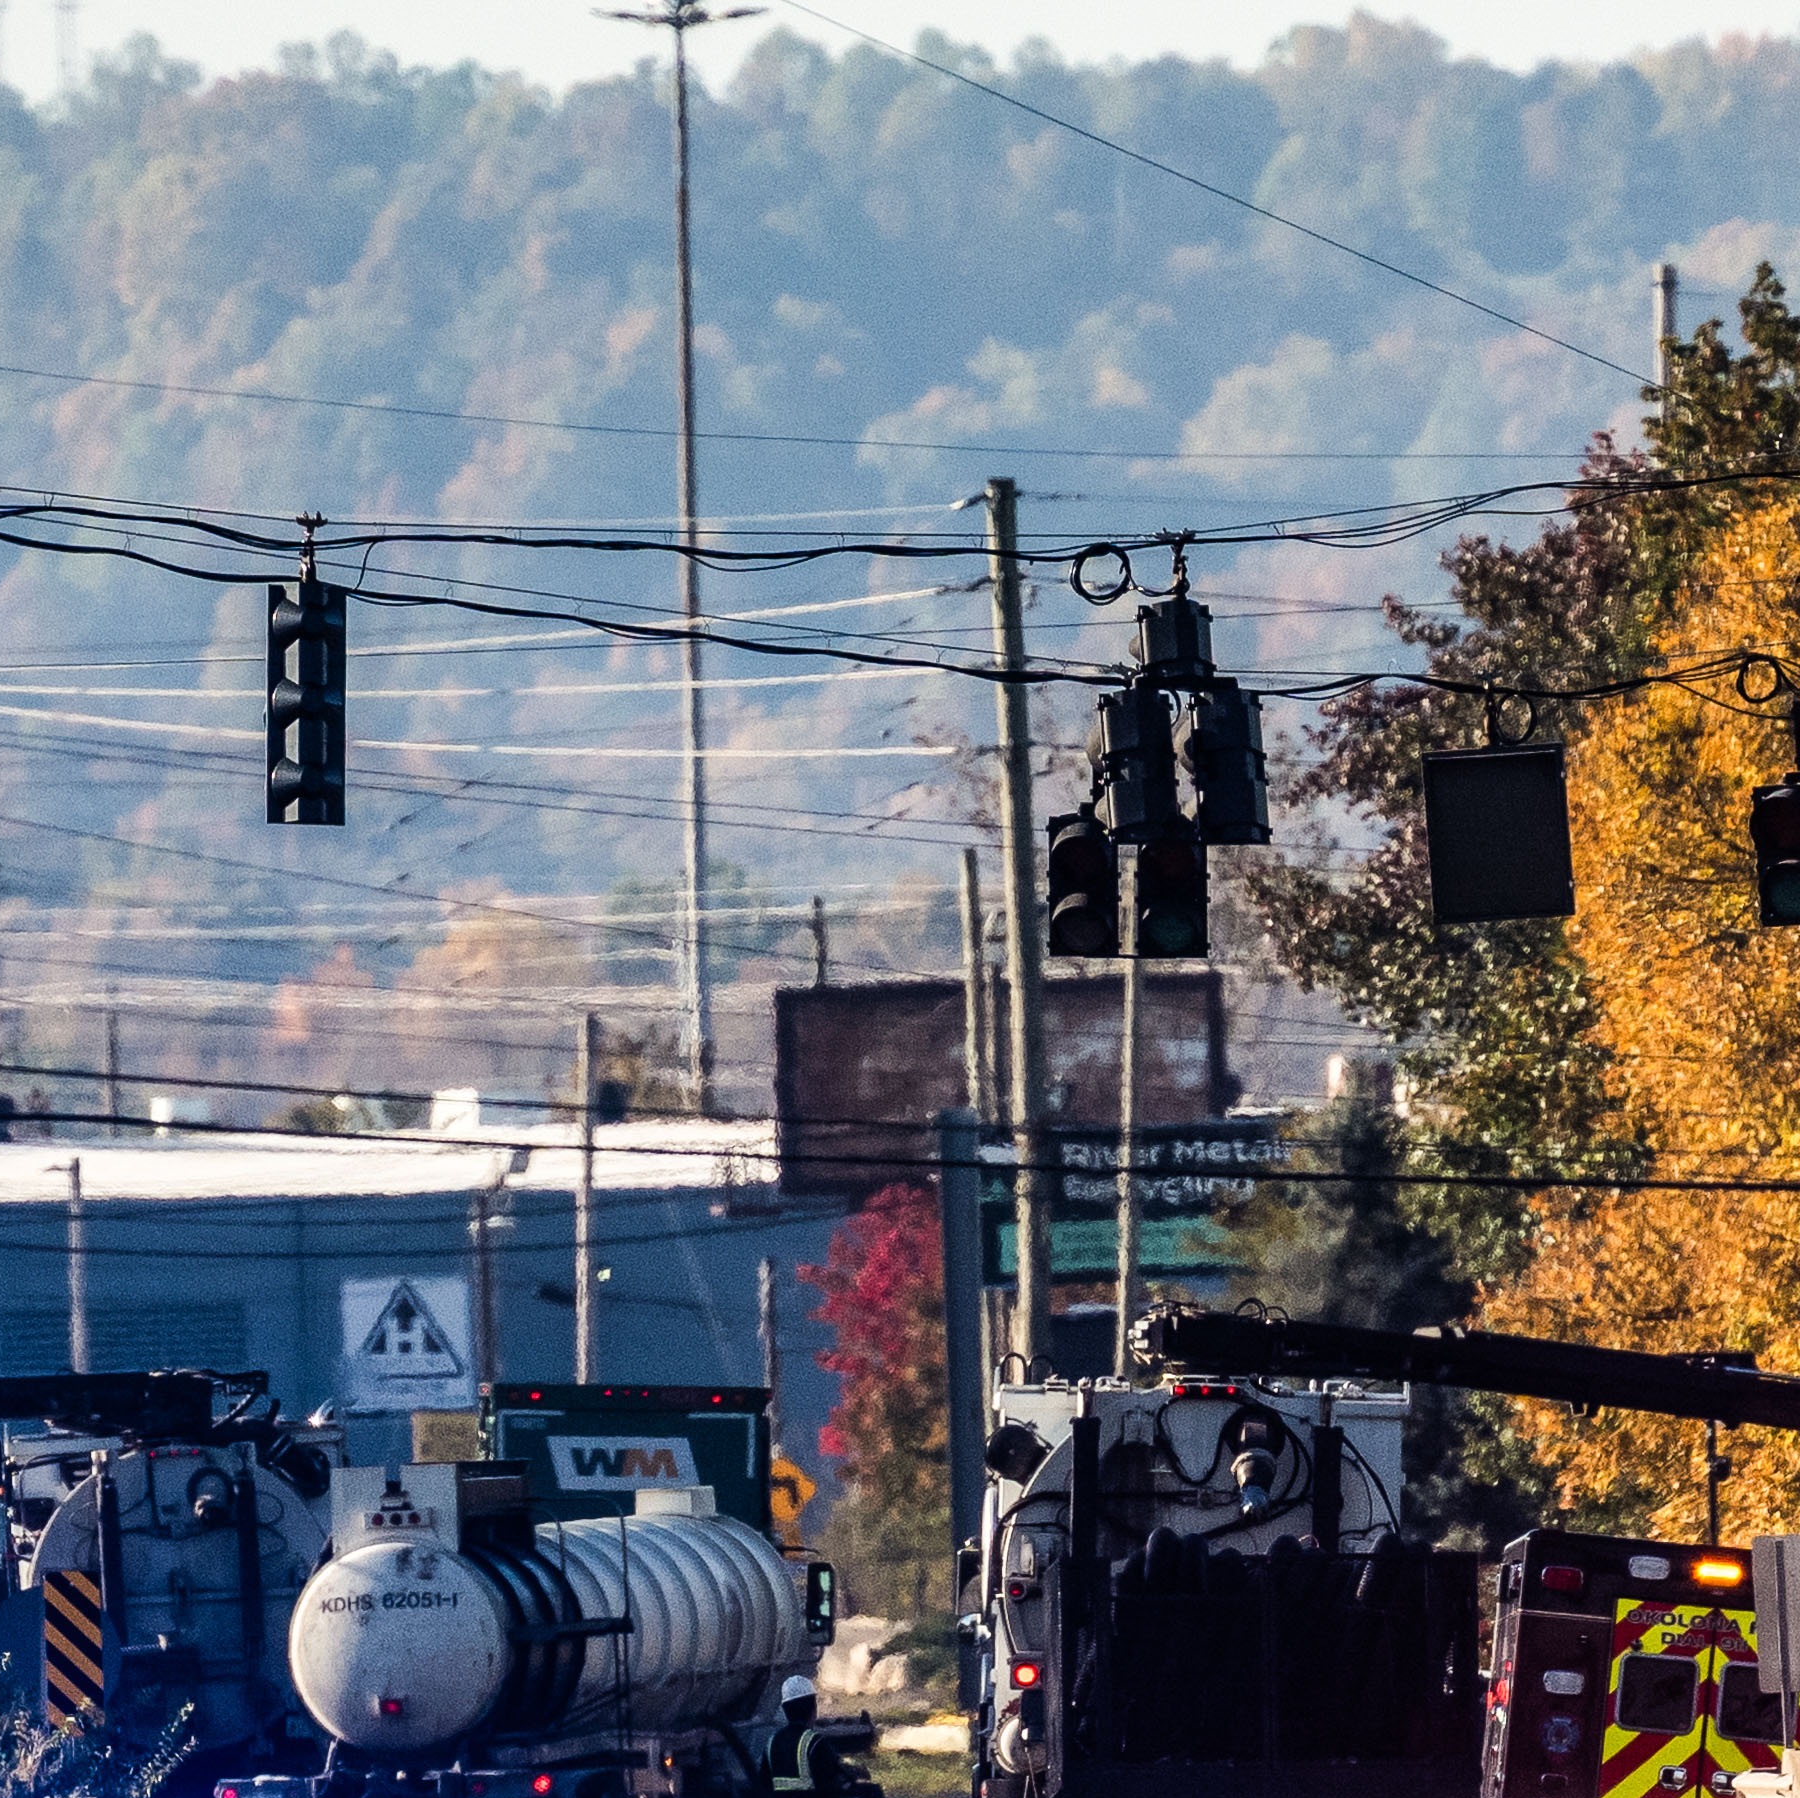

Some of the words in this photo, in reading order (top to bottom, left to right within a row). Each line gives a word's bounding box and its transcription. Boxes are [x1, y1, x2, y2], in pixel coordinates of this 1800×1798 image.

[570, 1448, 680, 1479] WM
[321, 1593, 373, 1614] KDHS
[1627, 1608, 1743, 1634] OKOLONA
[1661, 1632, 1705, 1649] DIAL
[1721, 1638, 1749, 1653] 911
